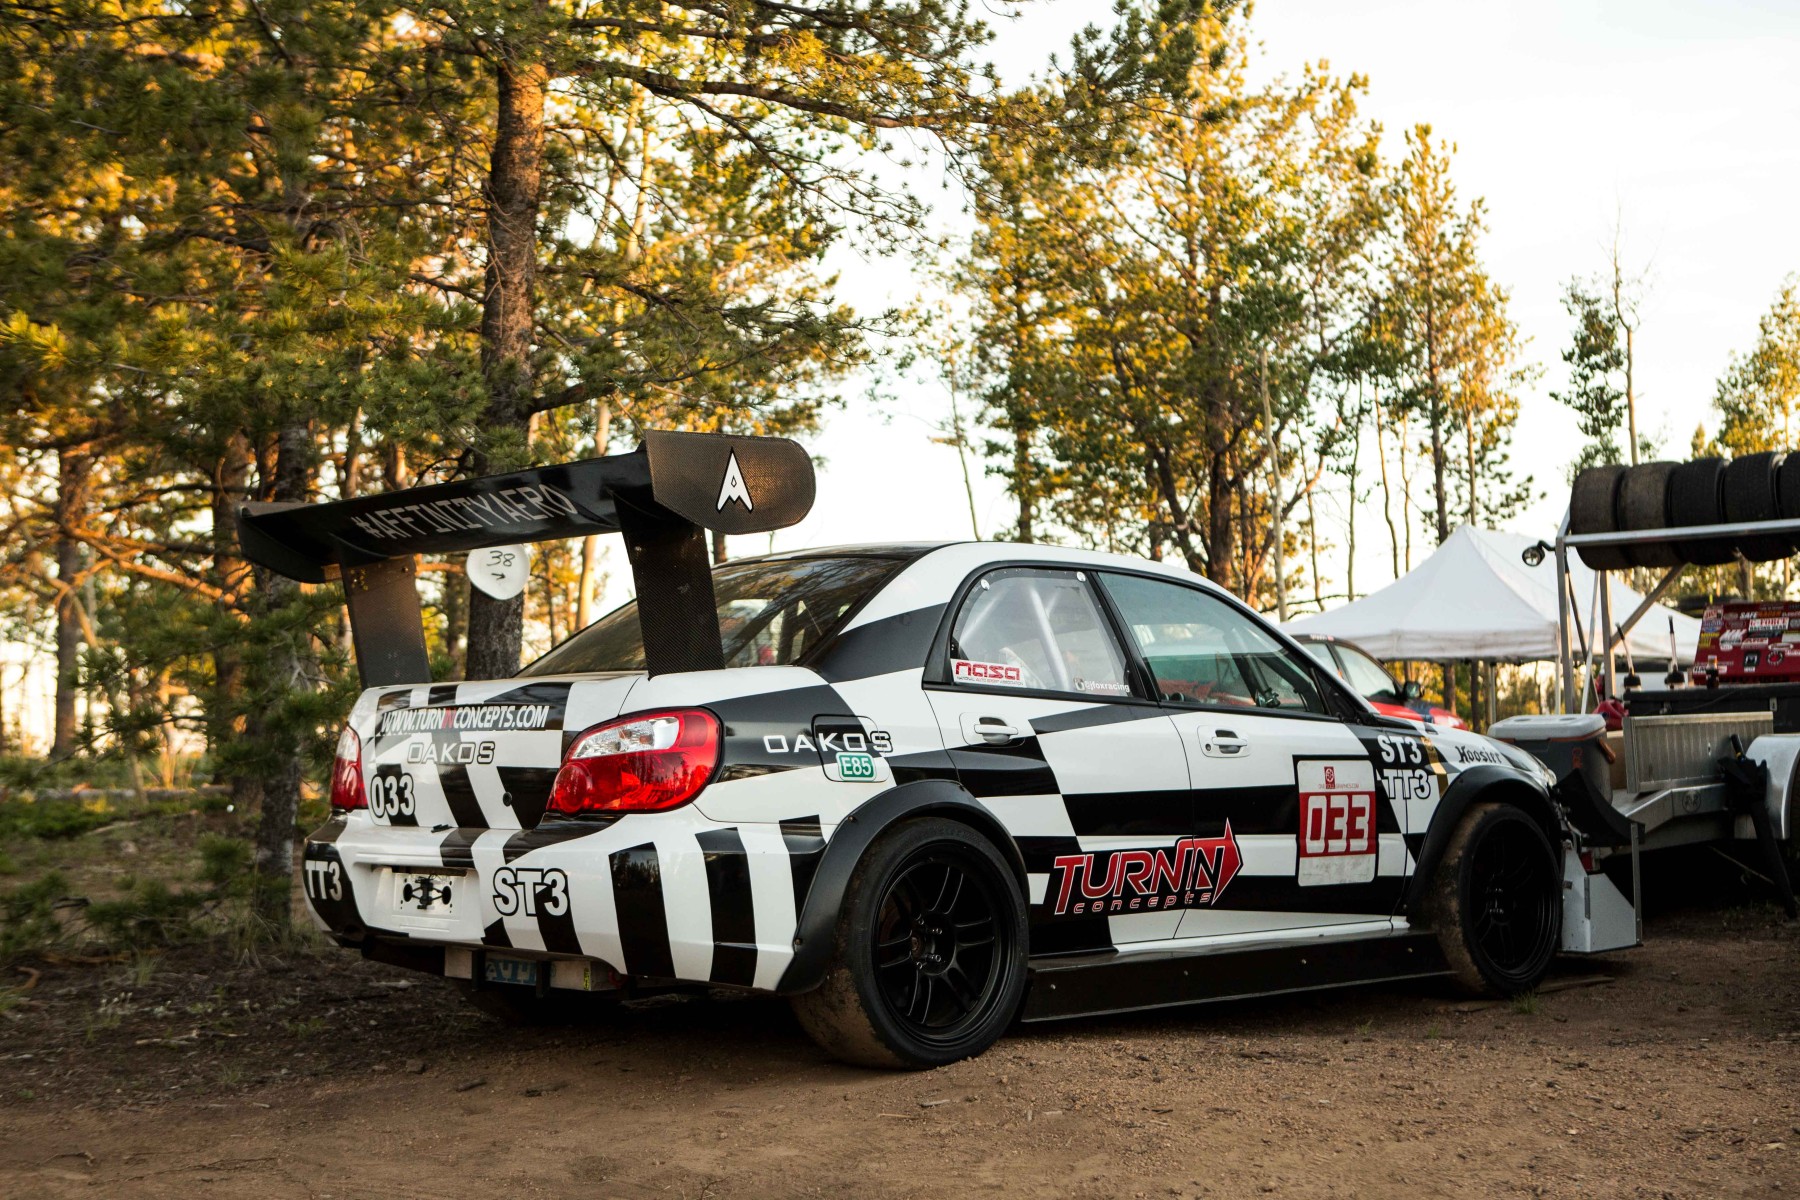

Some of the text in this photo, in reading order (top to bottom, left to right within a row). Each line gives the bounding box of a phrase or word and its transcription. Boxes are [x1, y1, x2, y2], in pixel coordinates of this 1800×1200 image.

[351, 484, 578, 540] #AFFINITYAERO
[486, 550, 515, 567] 38
[407, 741, 496, 765] OAKOS
[763, 731, 893, 753] OAKOS
[1377, 735, 1422, 764] ST3
[841, 757, 872, 775] E85
[370, 773, 415, 819] 033
[1381, 769, 1431, 800] TT3
[1306, 794, 1370, 854] 033
[305, 860, 343, 901] TT3
[493, 868, 568, 916] ST3
[1073, 892, 1212, 914] concepts
